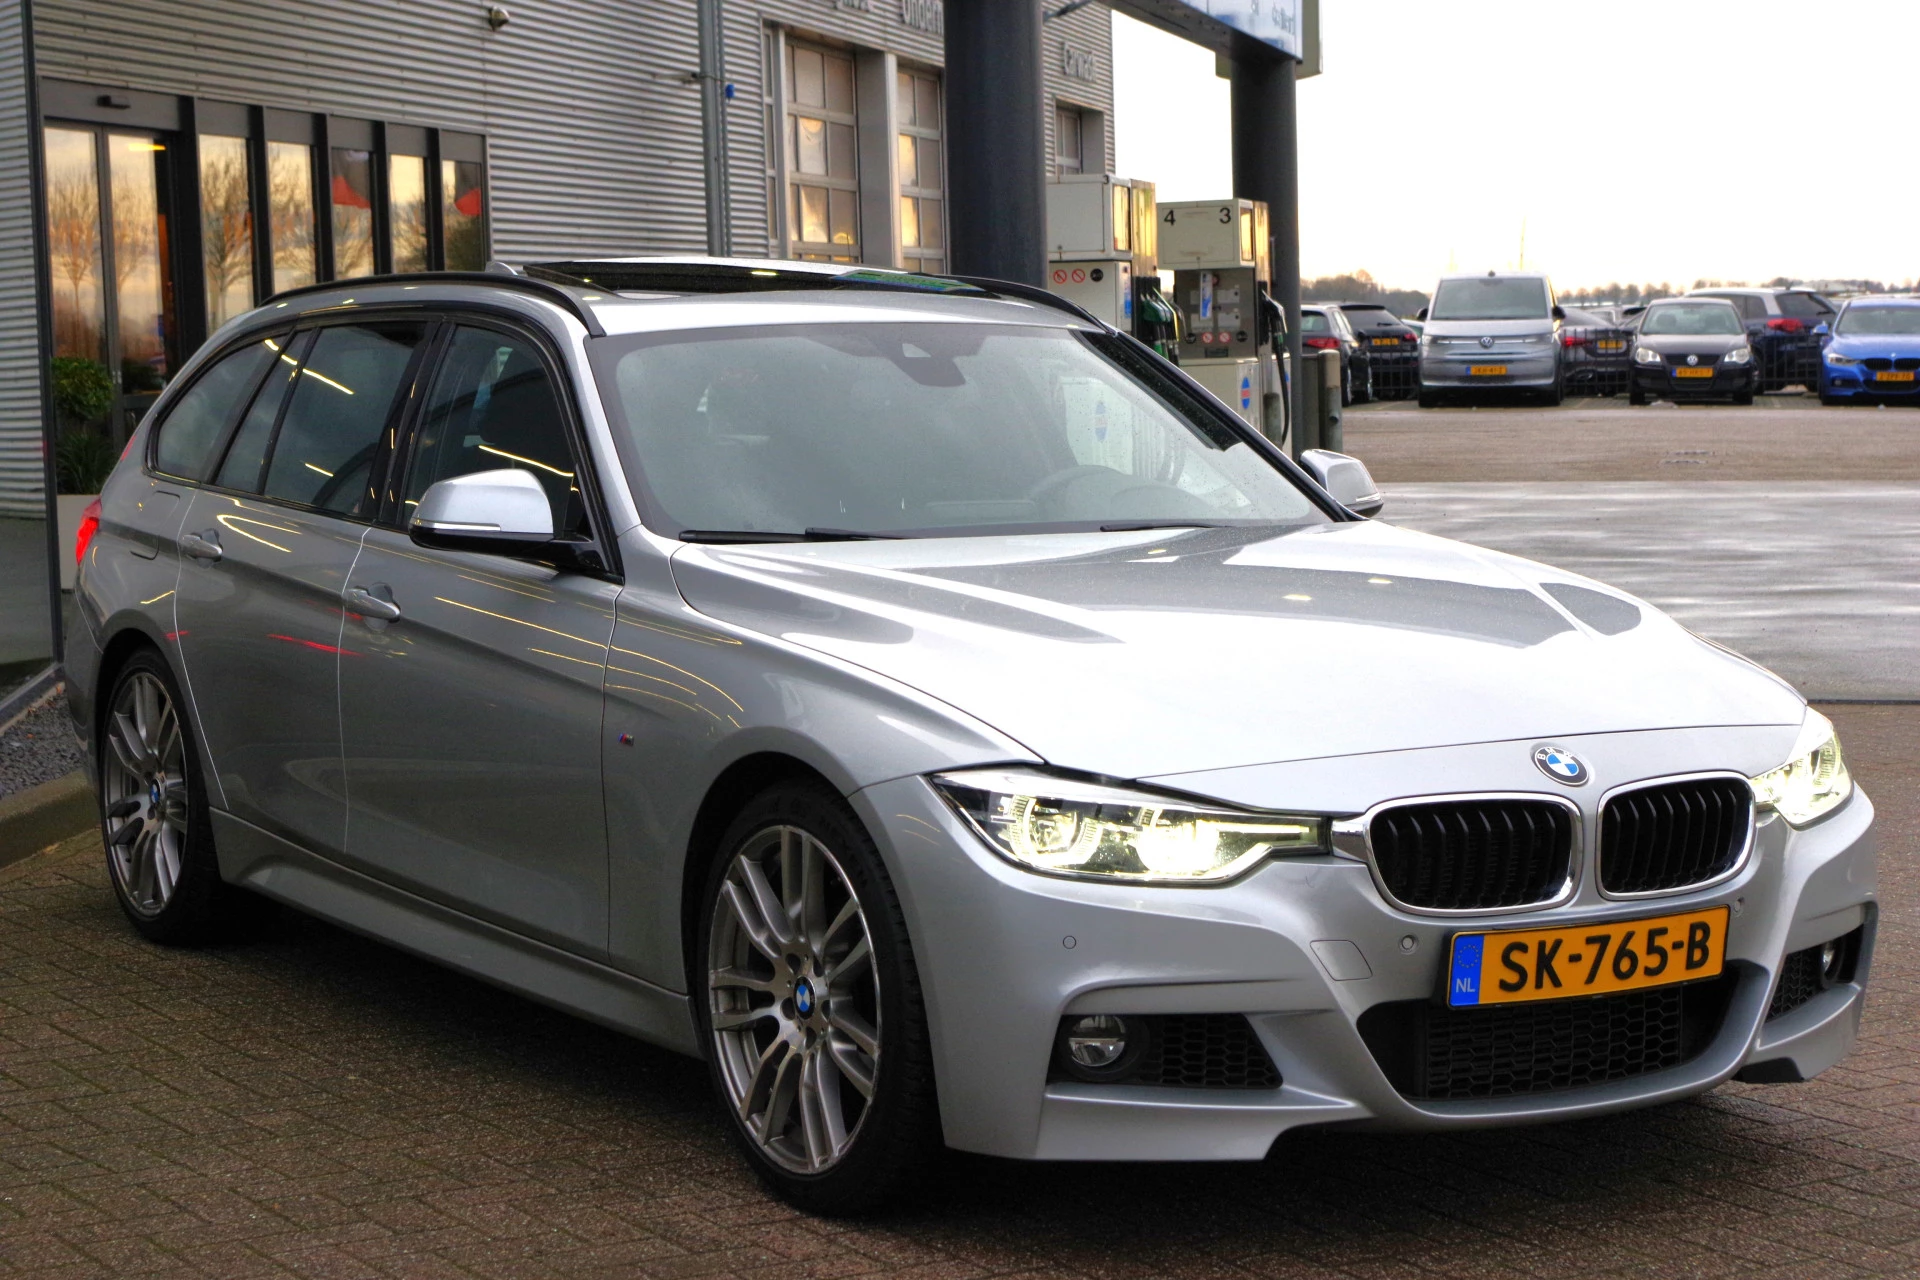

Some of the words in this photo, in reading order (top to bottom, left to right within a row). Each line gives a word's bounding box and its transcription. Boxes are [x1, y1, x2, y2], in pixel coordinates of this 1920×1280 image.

[1164, 209, 1176, 226] 4
[1219, 207, 1232, 224] 3
[1456, 978, 1476, 993] NL
[1499, 921, 1710, 993] SK-765-B
